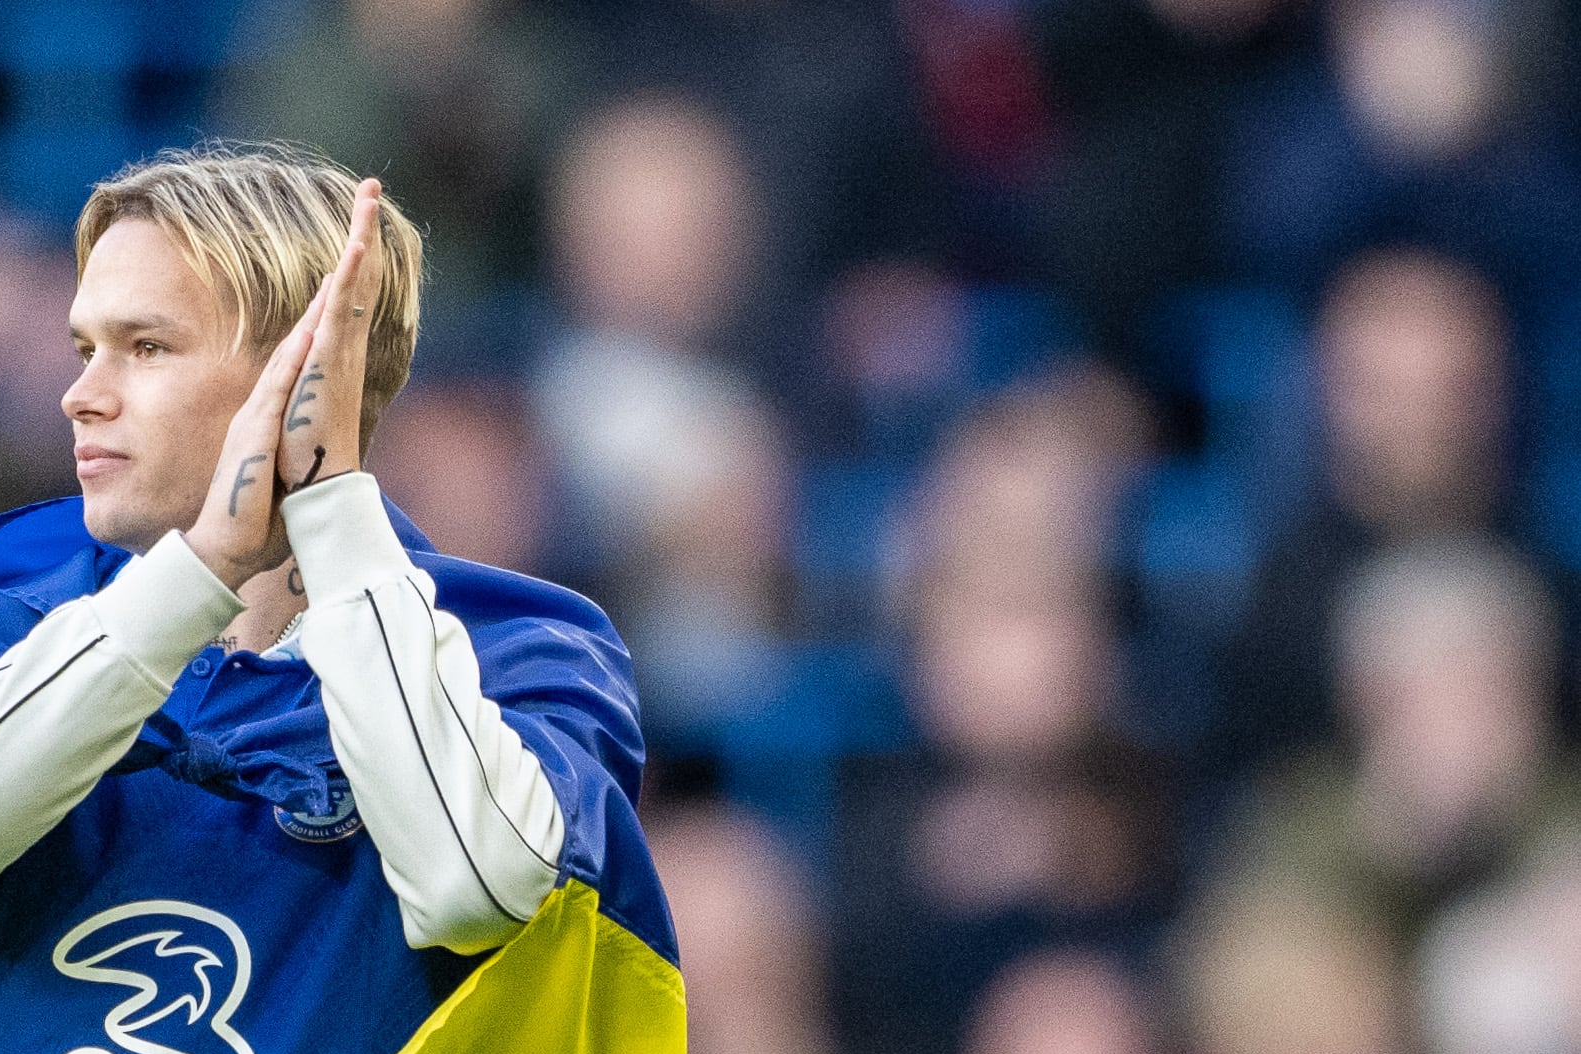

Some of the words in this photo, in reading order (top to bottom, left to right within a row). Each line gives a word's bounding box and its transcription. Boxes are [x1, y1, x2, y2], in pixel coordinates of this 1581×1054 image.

[287, 373, 324, 432] E
[229, 455, 267, 517] F
[287, 821, 330, 837] FOOTBALL
[334, 817, 357, 833] CLUB
